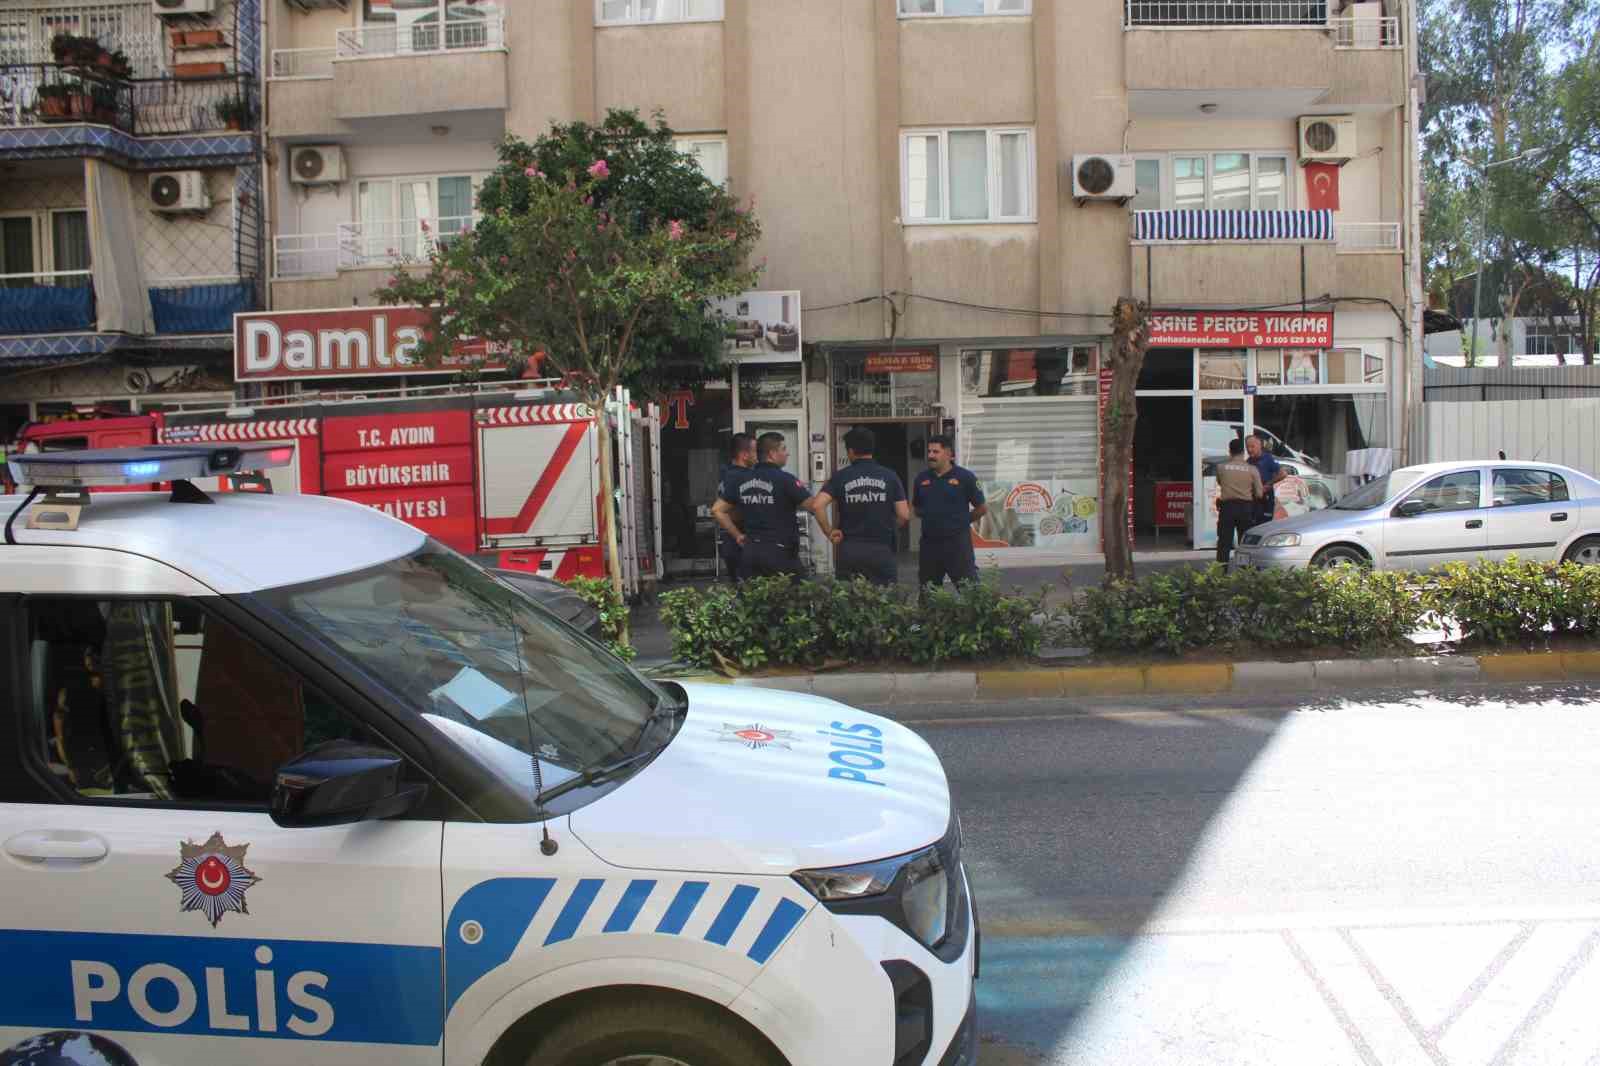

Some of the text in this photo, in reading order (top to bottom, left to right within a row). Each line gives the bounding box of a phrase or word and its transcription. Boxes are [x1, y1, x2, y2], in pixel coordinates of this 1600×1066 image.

[1144, 315, 1328, 335] SANE PERDE YIKAMA
[245, 314, 422, 370] Damla
[357, 425, 435, 448] T.C. AYDIN
[344, 460, 450, 487] BÜYÜKŞEHİR
[372, 495, 447, 518] AİYESİ
[816, 720, 886, 787] POLİS
[70, 945, 335, 1037] POLİS
